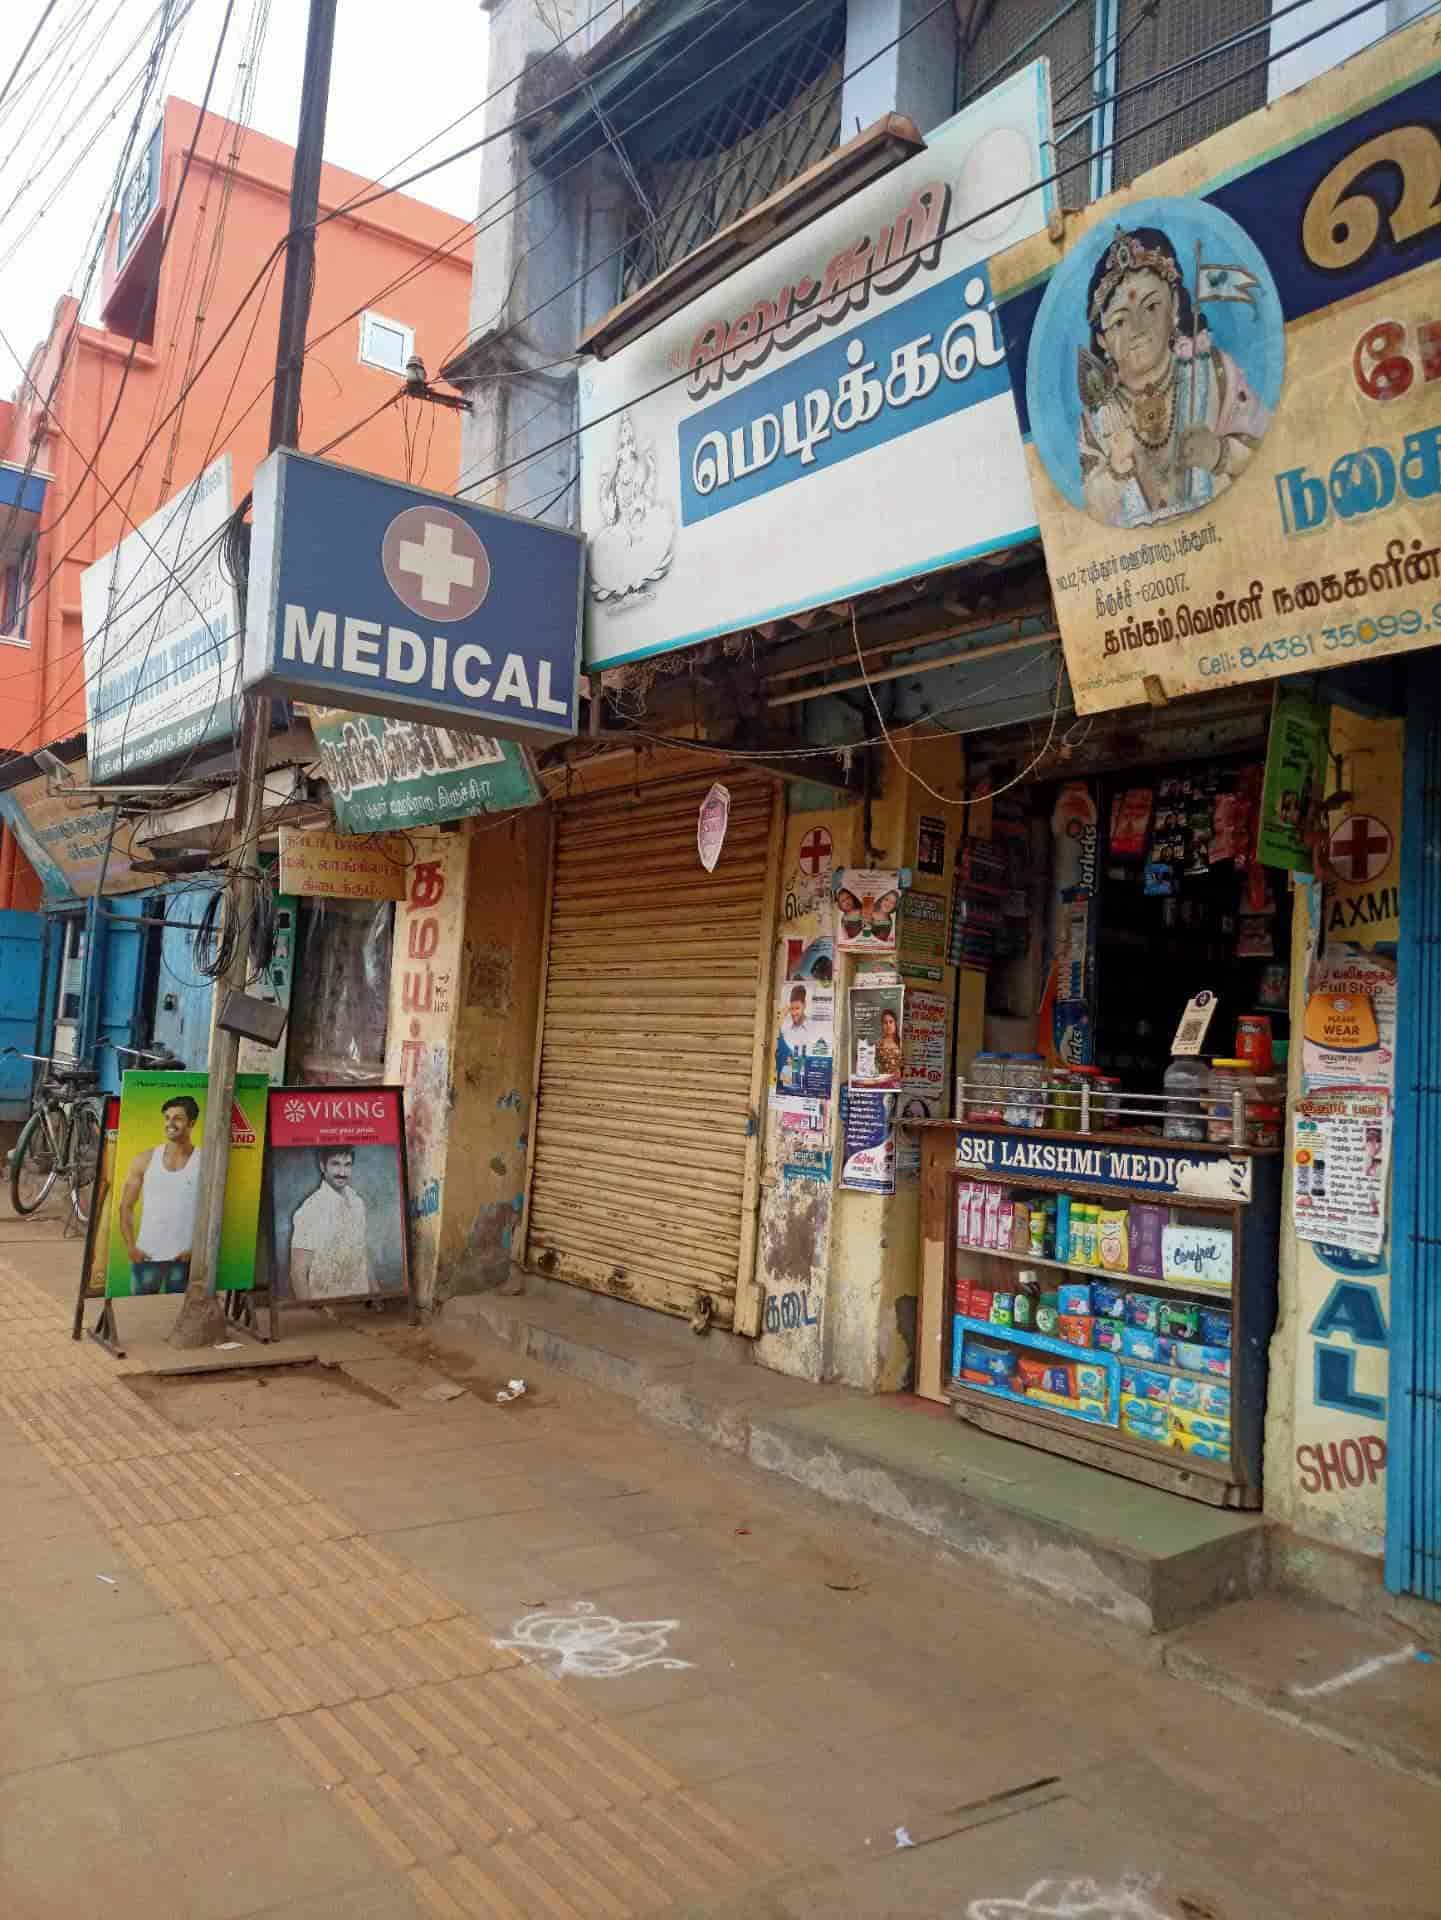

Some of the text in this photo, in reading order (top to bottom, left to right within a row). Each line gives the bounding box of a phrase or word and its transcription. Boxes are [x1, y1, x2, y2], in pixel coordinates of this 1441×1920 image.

[692, 276, 1007, 495] மெடிக்கல்
[282, 604, 568, 715] MEDICAL
[1199, 653, 1237, 677] Cell:
[1239, 635, 1314, 669] 84381
[1324, 1024, 1360, 1036] WEAR
[307, 1101, 385, 1119] VIKING
[960, 1137, 994, 1163] SRI
[1001, 1142, 1101, 1177] LAKSHMI
[1296, 1435, 1387, 1494] SHOP
